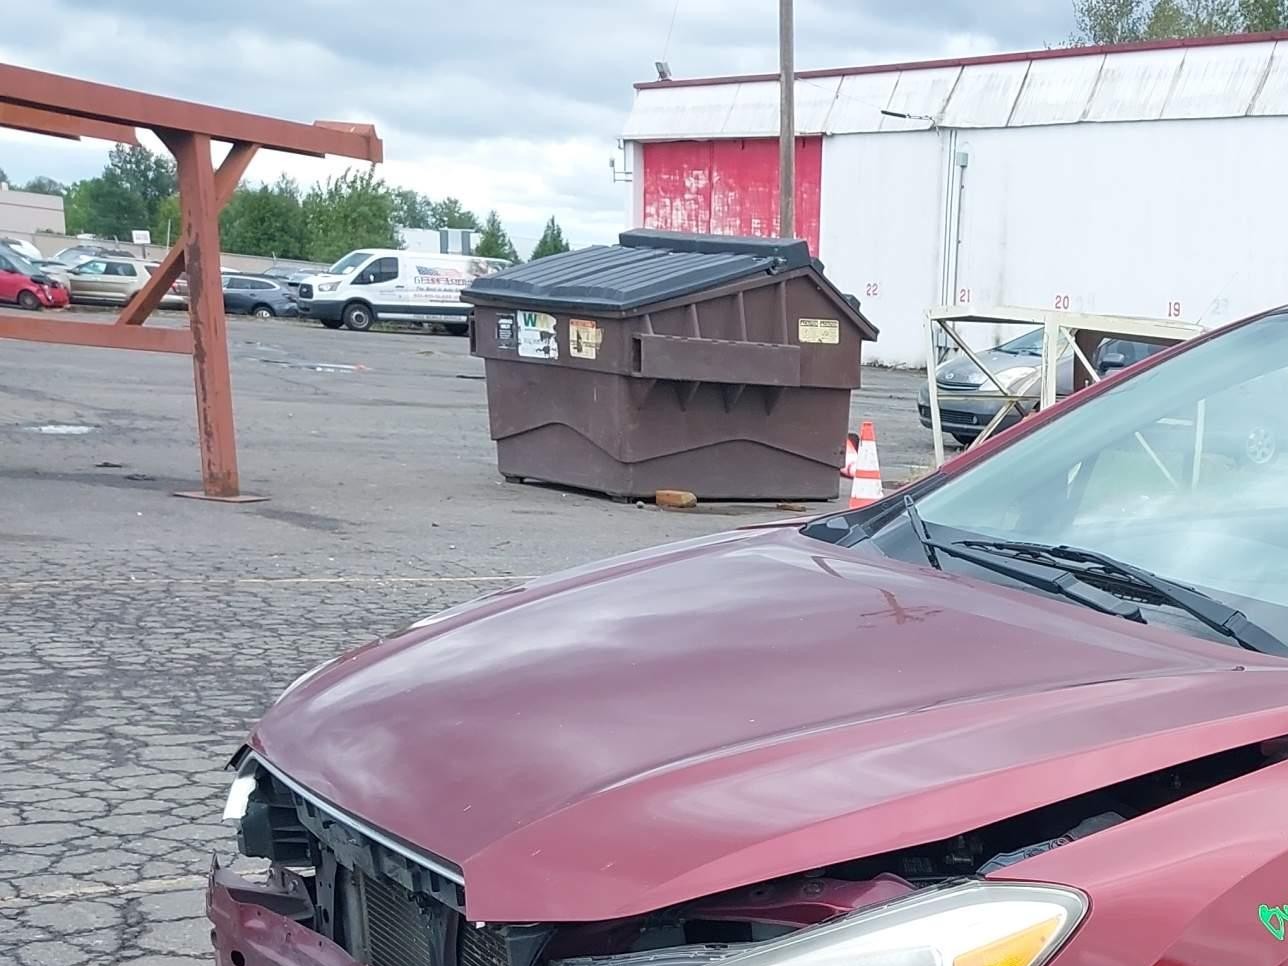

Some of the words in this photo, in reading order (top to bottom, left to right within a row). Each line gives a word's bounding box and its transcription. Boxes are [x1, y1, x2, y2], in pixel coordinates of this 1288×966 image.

[866, 283, 879, 297] 22
[959, 289, 971, 303] 21
[1055, 295, 1070, 310] 20
[1167, 301, 1181, 317] 19
